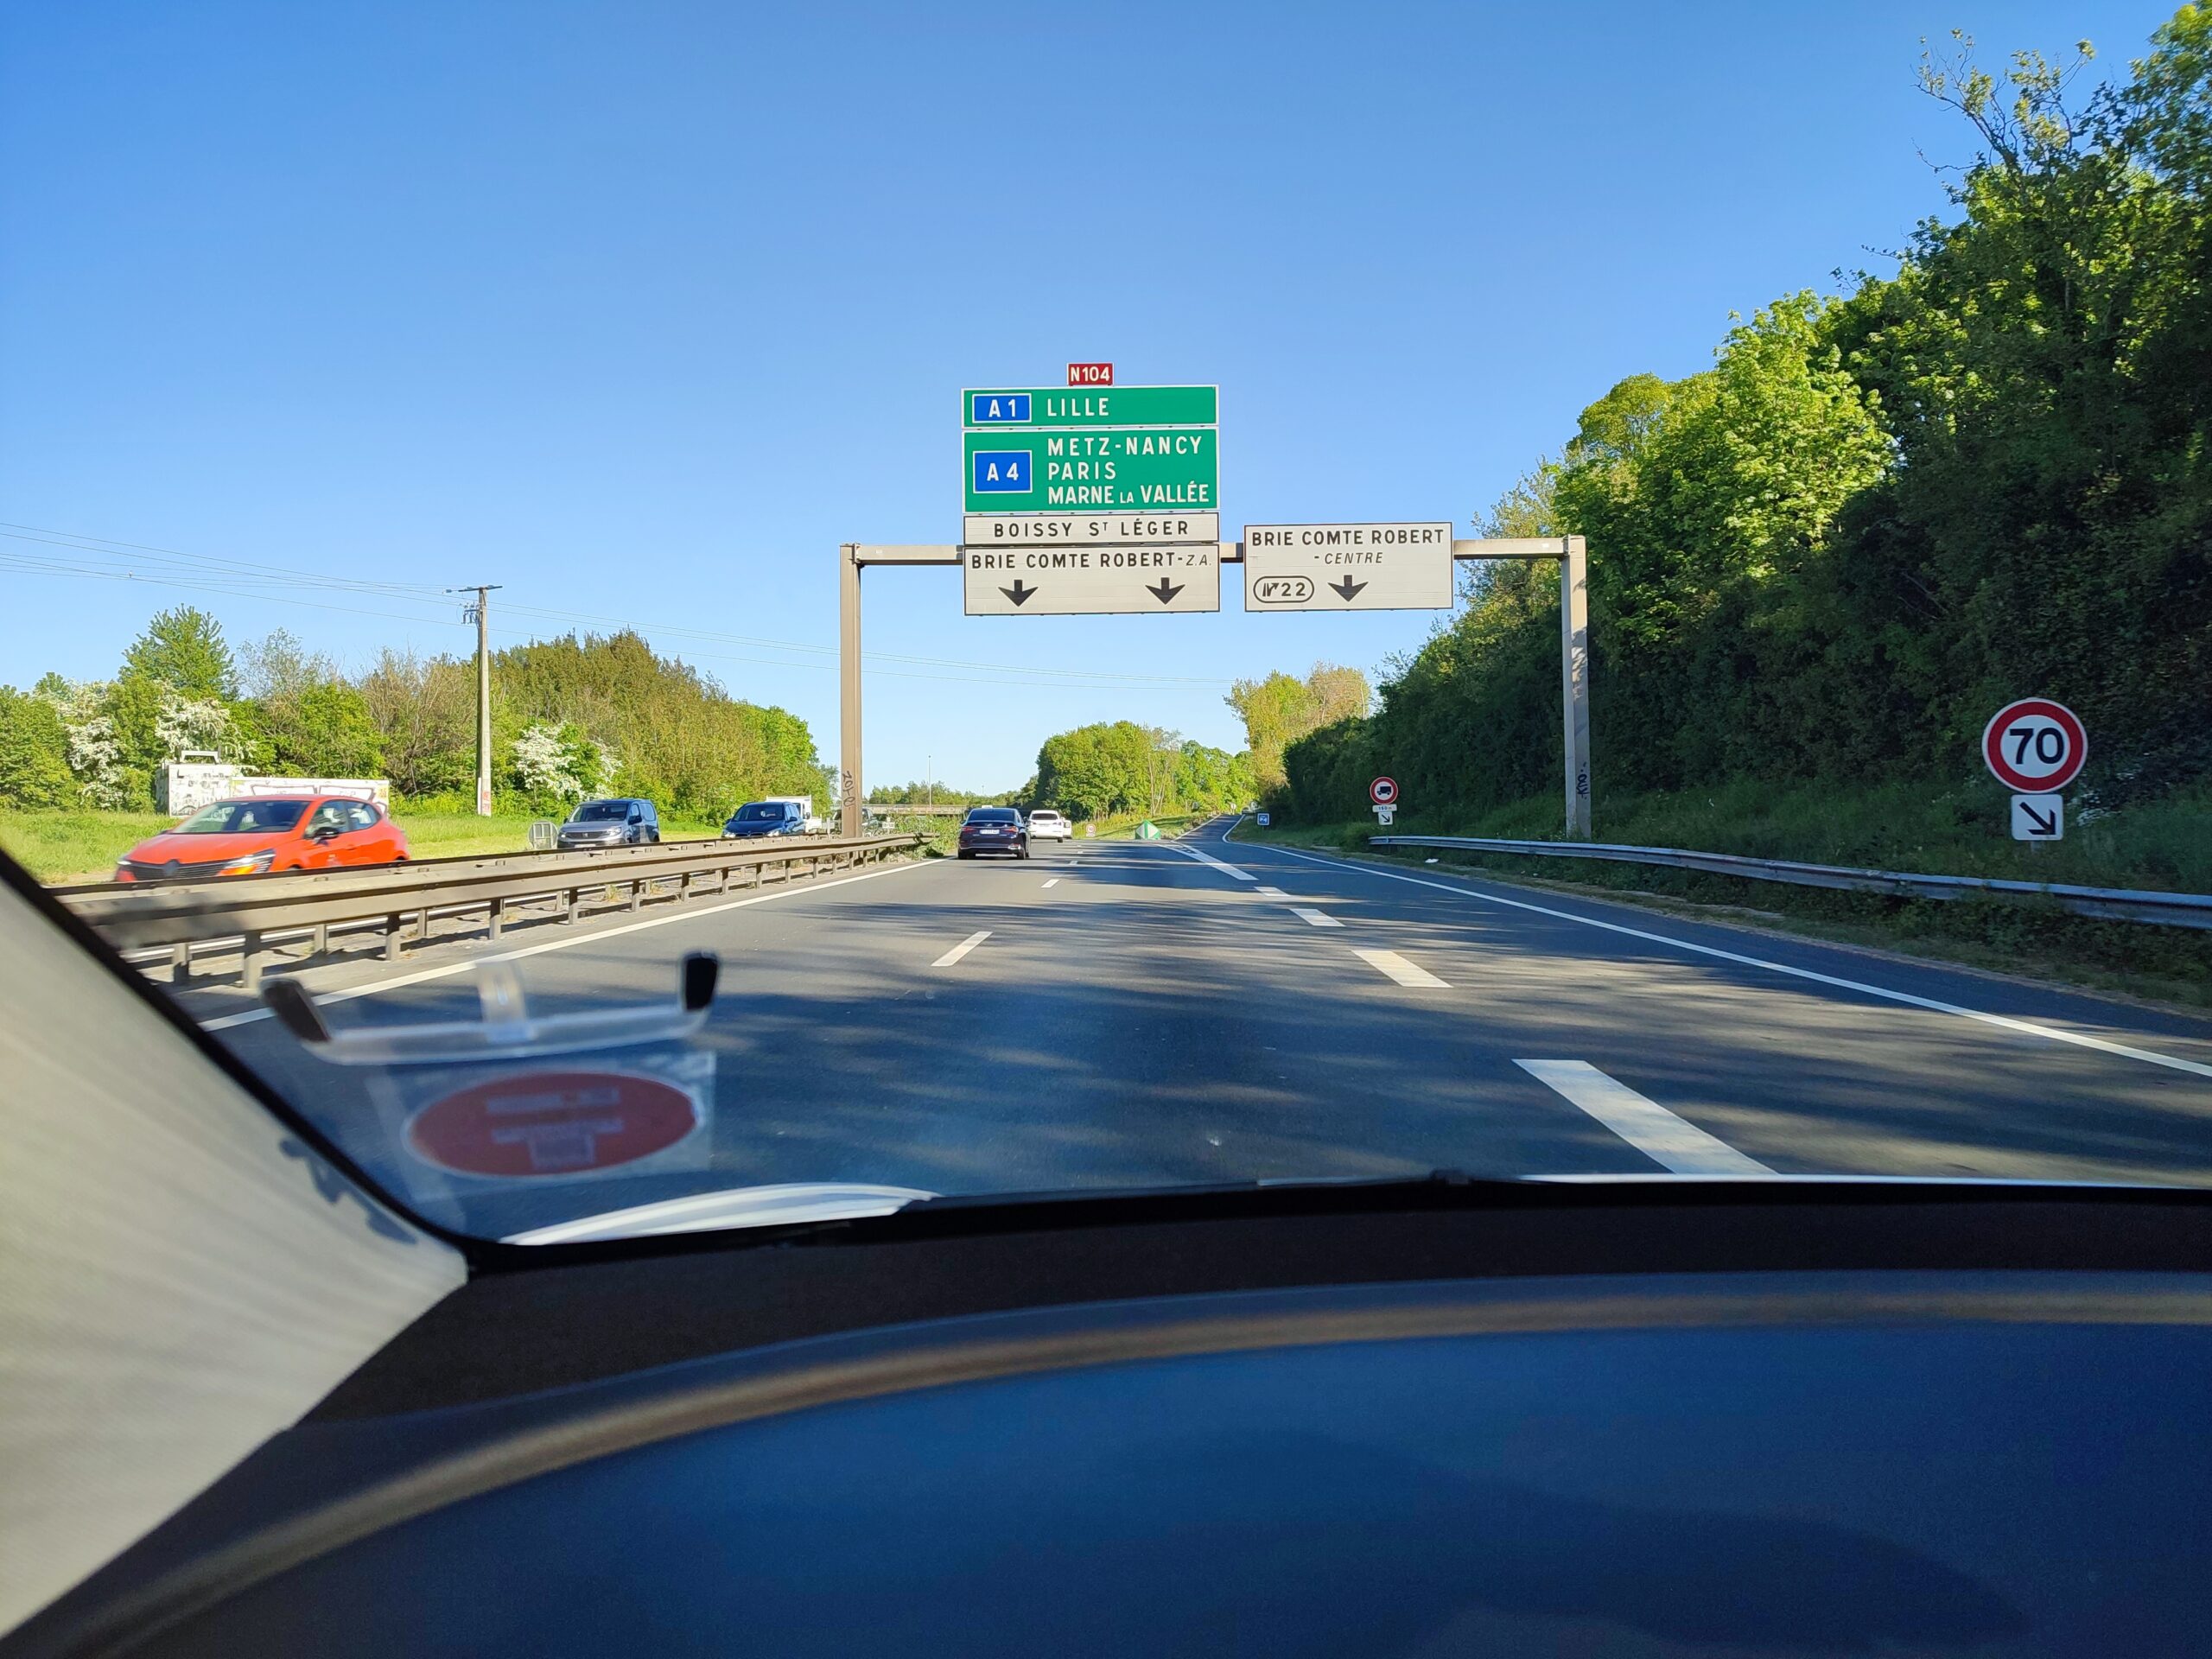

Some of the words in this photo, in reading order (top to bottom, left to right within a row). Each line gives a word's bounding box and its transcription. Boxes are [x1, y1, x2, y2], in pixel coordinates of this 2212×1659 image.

[1071, 366, 1110, 382] N104
[1046, 397, 1109, 416] LILLE
[1047, 435, 1202, 456] METZ-NANCY
[1048, 461, 1116, 480] PARIS
[1048, 486, 1114, 505] MARNE
[1120, 492, 1135, 504] LA
[1140, 480, 1209, 504] VALLÉE
[994, 523, 1072, 537] BOISSY
[1121, 518, 1189, 536] LÉGER
[1252, 531, 1294, 546] BRIE
[1301, 530, 1363, 545] COMTE
[1371, 529, 1444, 544] ROBERT
[971, 554, 1015, 569] BRIE
[1026, 553, 1090, 569] COMTE
[1281, 582, 1306, 596] 22
[2009, 727, 2064, 765] 70
